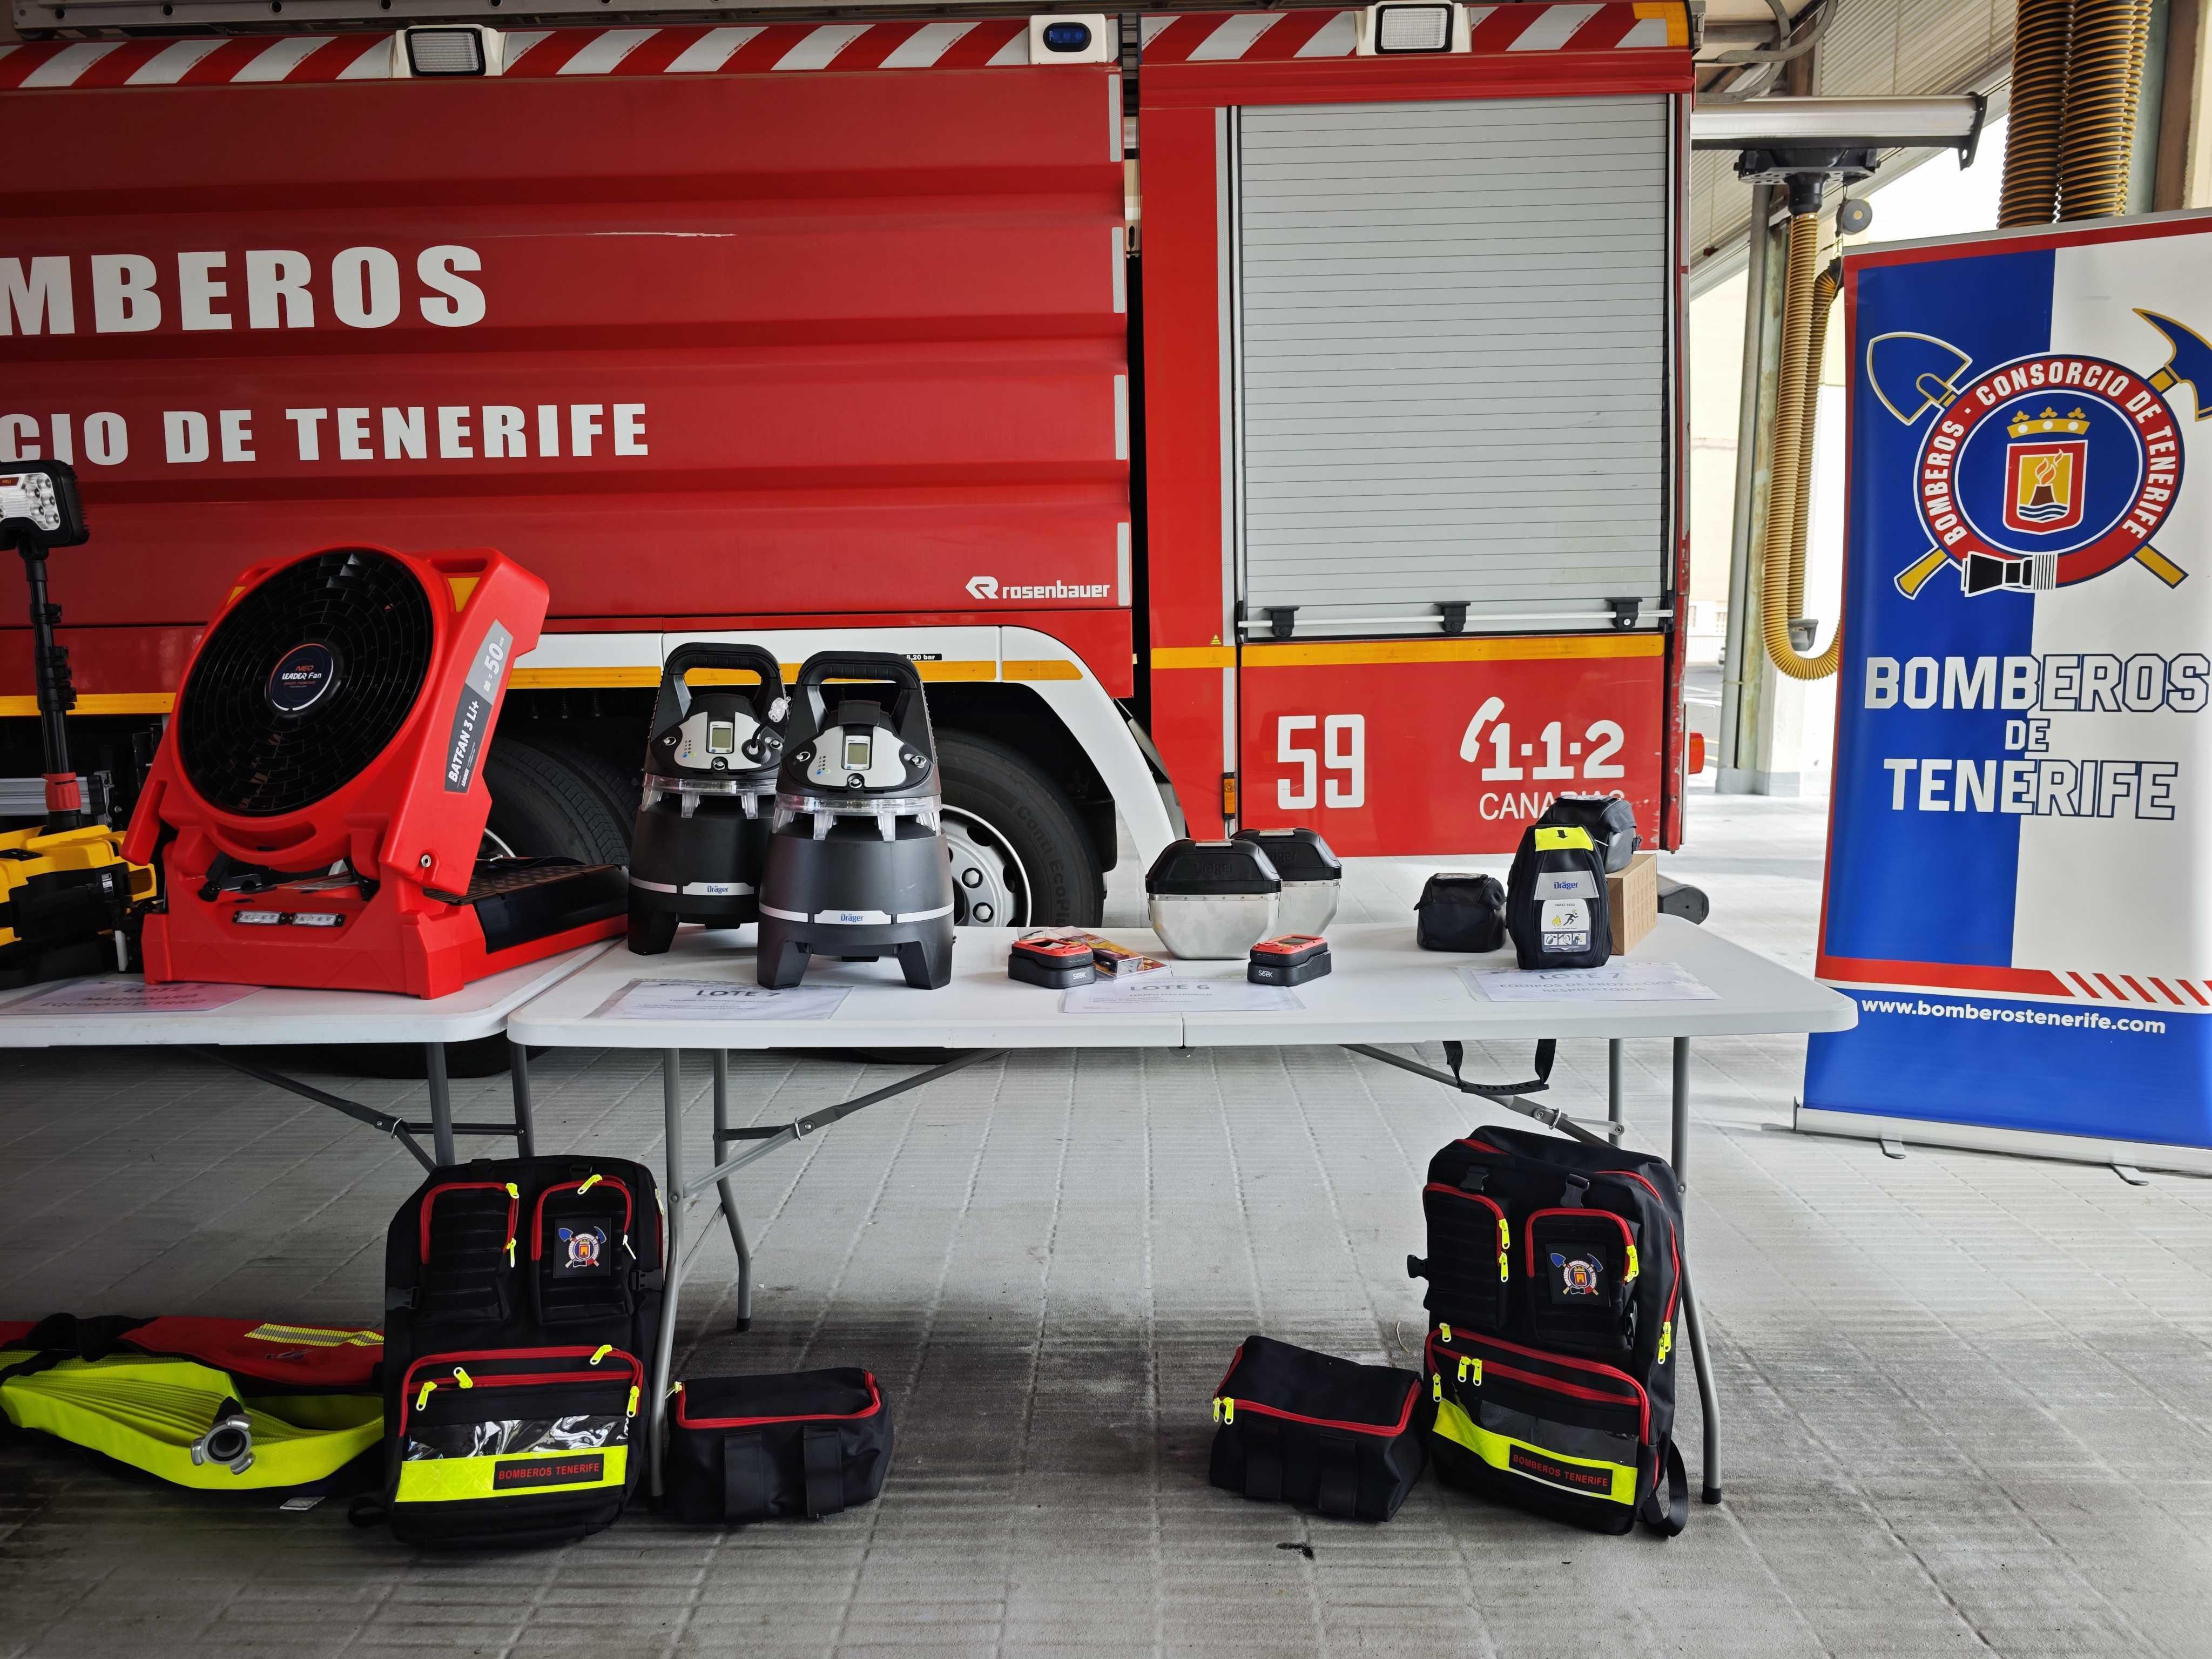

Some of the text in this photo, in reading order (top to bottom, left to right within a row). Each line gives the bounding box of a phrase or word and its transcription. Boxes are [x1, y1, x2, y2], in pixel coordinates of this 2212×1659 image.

[163, 409, 256, 463] DE
[286, 403, 648, 461] TENERIFE
[1925, 361, 2175, 545] BOMBEROS CONSORCIO DE TENERIFE
[1002, 580, 1110, 599] rosenbauer
[484, 643, 503, 675] 50
[1864, 653, 2211, 713] BOMBEROS
[463, 719, 473, 731] 3
[466, 700, 480, 721] Li+
[2005, 718, 2051, 753] DE
[448, 730, 470, 783] BATFAN
[1277, 714, 1365, 810] 59
[1883, 758, 2179, 821] TENERIFE
[707, 885, 729, 894] Dräger
[1554, 881, 1578, 890] Dräger
[840, 913, 864, 922] Dräger
[1862, 999, 2166, 1034] www.bomberostenerife.com
[498, 1462, 599, 1480] BOMBEROS TENERIFE
[1513, 1454, 1608, 1487] BOMBEROS TENERIFE
